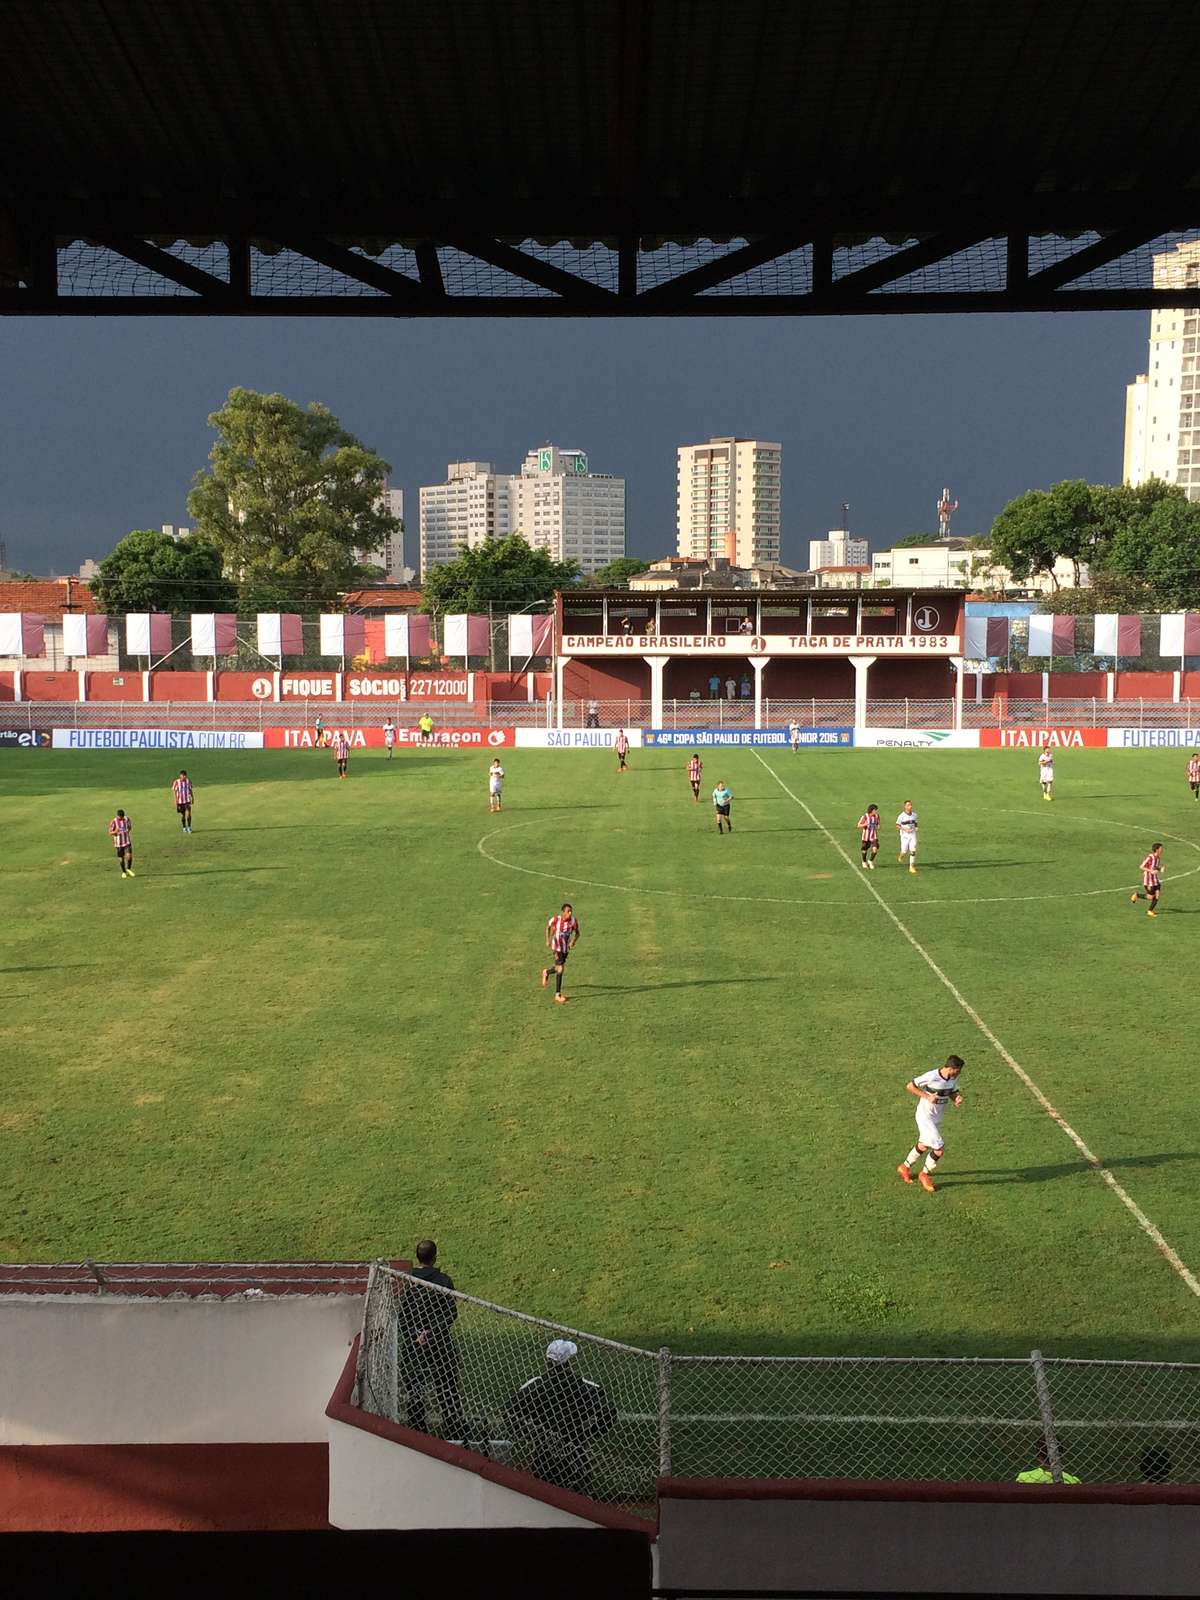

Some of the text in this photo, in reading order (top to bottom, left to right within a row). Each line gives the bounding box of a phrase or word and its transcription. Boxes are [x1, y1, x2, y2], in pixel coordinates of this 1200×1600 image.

[639, 637, 727, 648] BRASILEIRO
[789, 637, 948, 649] TAÇA DE PRATA 1983
[282, 679, 333, 697] FIQUE
[350, 677, 400, 696] SÓCIO
[410, 679, 467, 696] 22712000
[0, 730, 18, 739] rtão
[69, 730, 246, 748] FUTEBOLPAULISTA.COM.BR
[547, 730, 612, 746] SÃO PAULO
[673, 733, 695, 744] COPA
[696, 731, 712, 744] SÃO
[714, 733, 739, 744] PAULO
[741, 733, 752, 744] DE
[753, 733, 787, 744] FUTEBOL
[788, 733, 818, 744] JNIOR
[819, 733, 838, 743] 2015
[1000, 729, 1084, 747] ITAIPAVA
[877, 739, 934, 747] PENALTY
